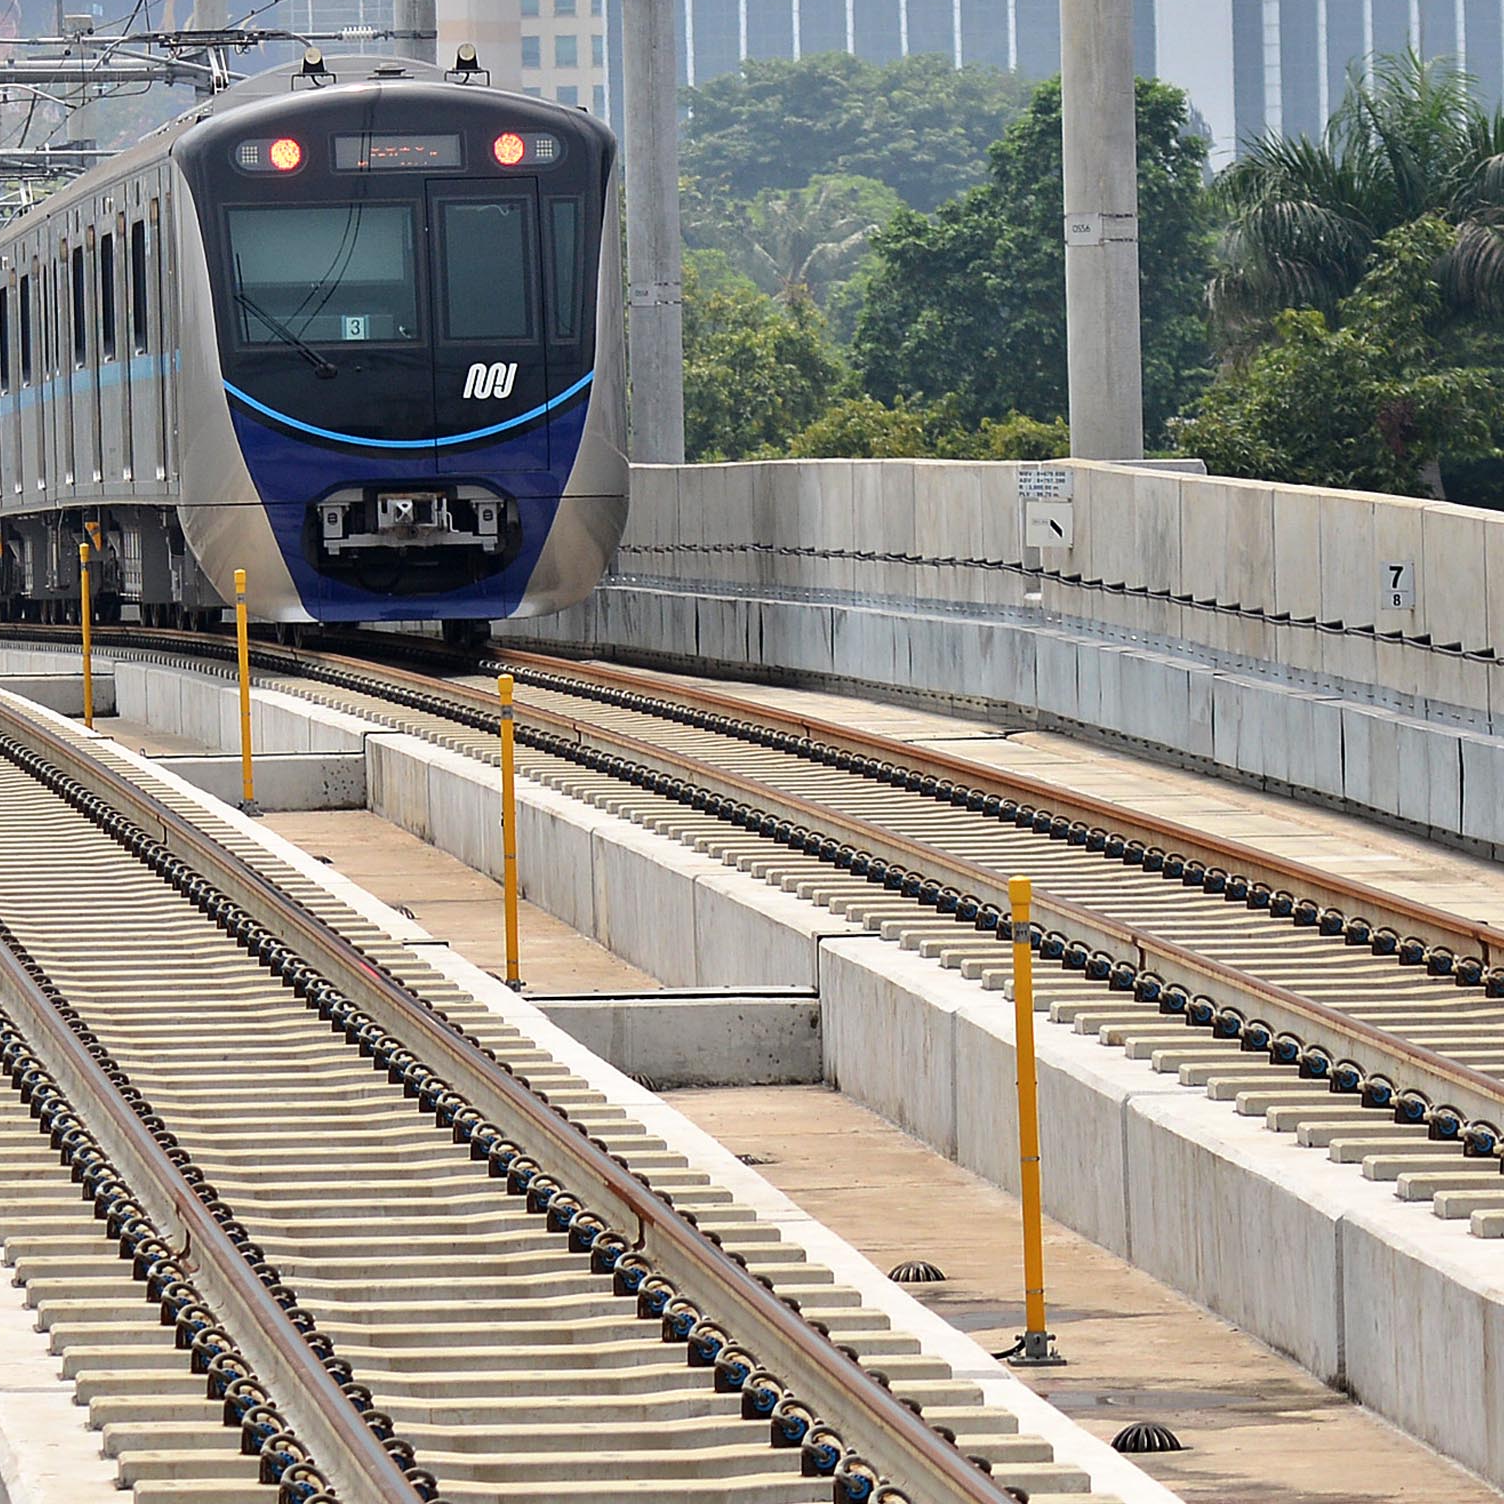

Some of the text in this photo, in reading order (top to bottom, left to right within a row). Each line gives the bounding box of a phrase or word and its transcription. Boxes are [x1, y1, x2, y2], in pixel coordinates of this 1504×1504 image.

[350, 320, 361, 336] 3
[1389, 565, 1404, 589] 7
[1393, 593, 1401, 606] 8
